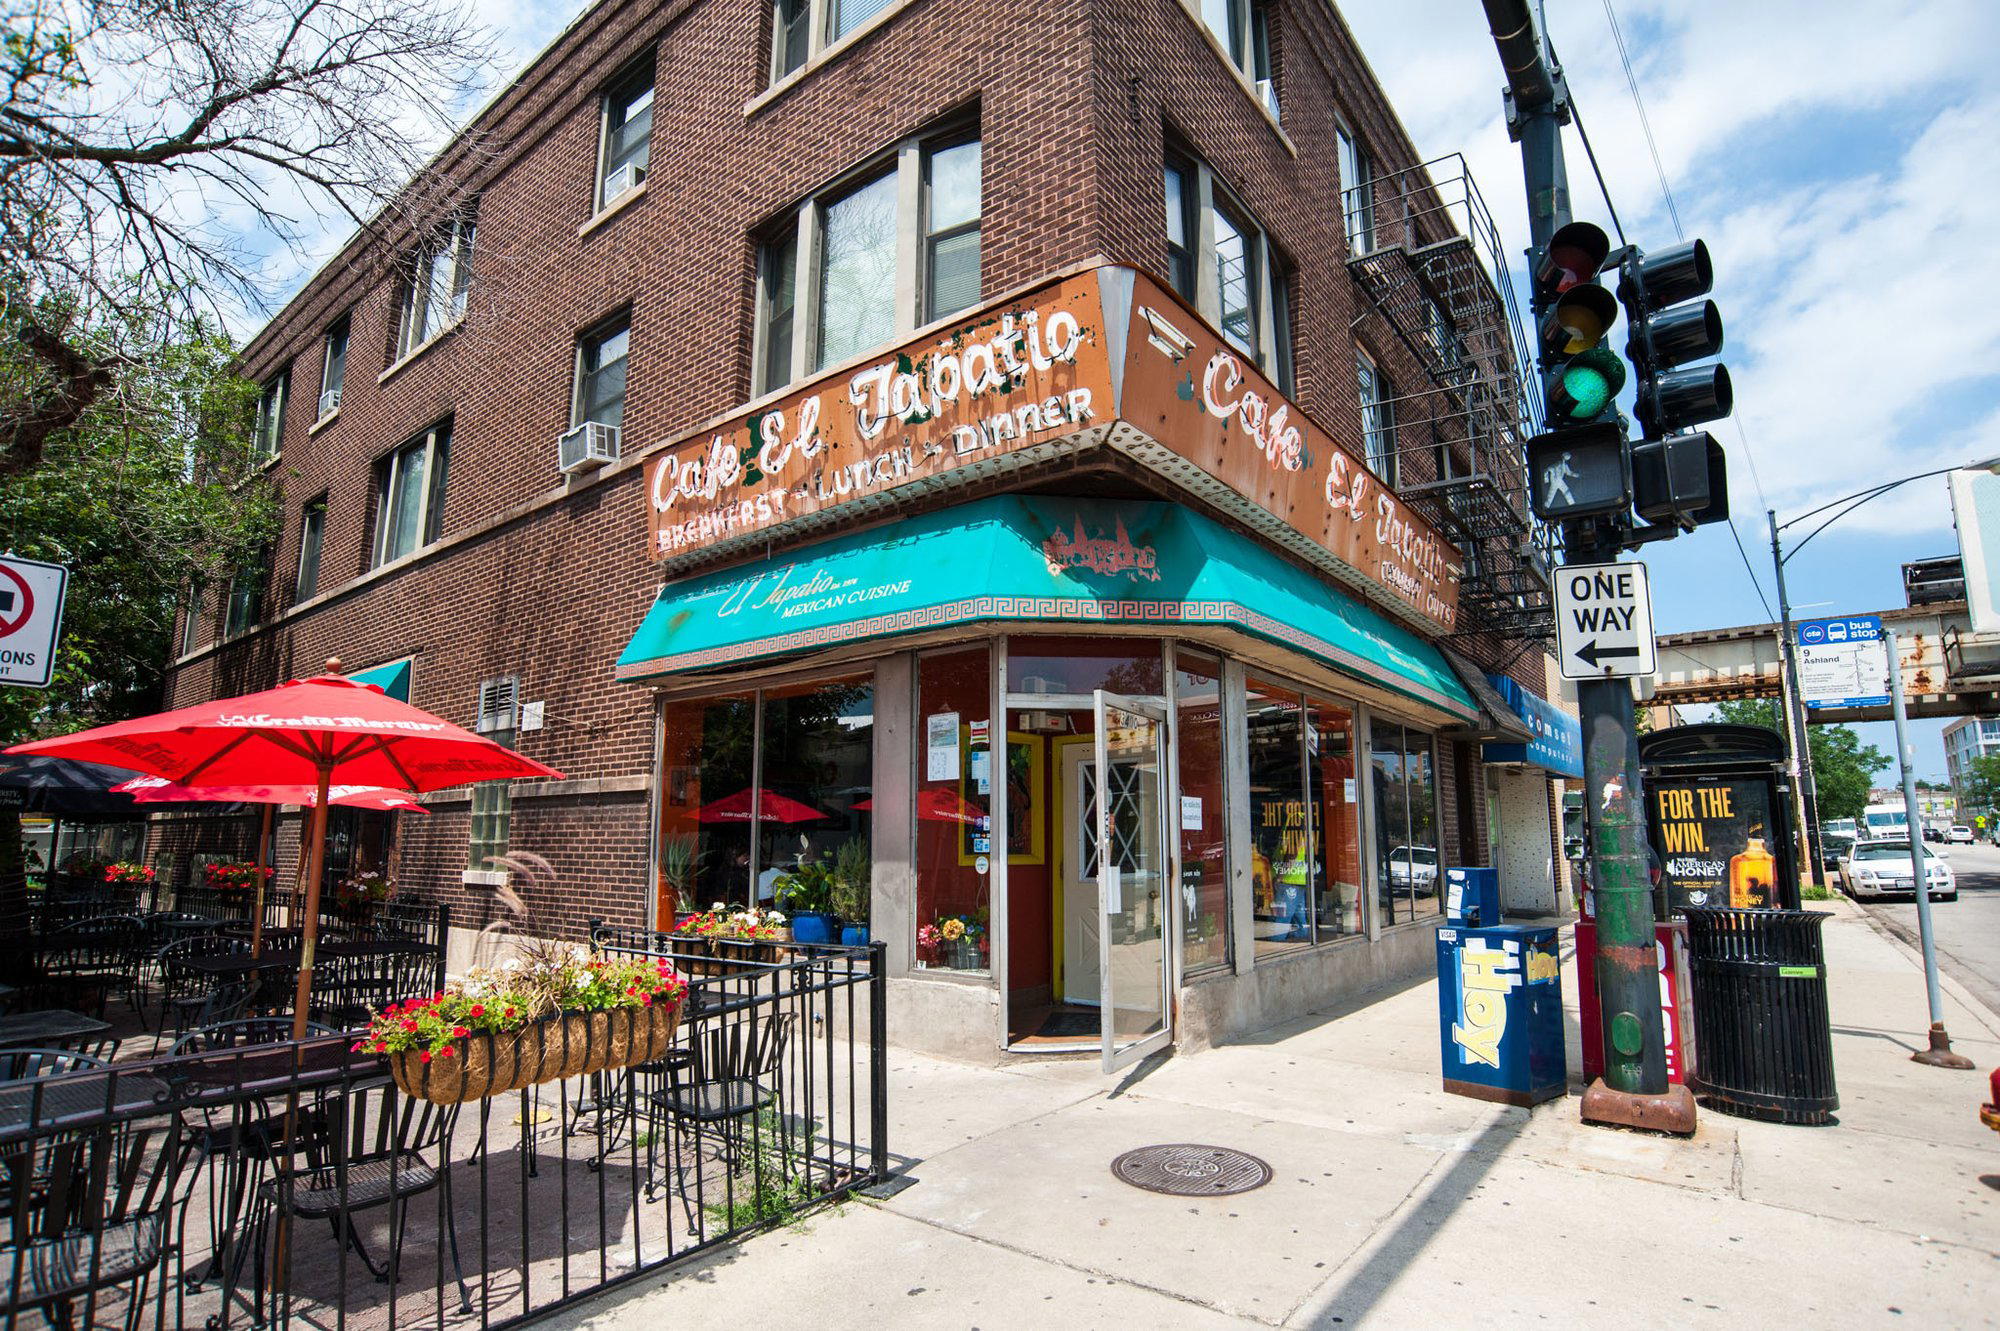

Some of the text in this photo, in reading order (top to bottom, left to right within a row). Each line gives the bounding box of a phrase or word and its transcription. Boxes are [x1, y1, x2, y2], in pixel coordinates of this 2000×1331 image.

[651, 309, 1081, 513] Cafe El Tapatio
[1203, 351, 1303, 472] Cafe
[1325, 451, 1368, 522] El
[718, 562, 834, 618] El Tapatio
[781, 594, 845, 619] MEXICAN
[847, 580, 912, 604] CUISINE
[1570, 573, 1635, 602] ONE
[1573, 605, 1636, 633] WAY
[1849, 621, 1872, 630] bus
[1850, 629, 1878, 639] stop
[0, 650, 35, 666] ONS
[1803, 649, 1811, 657] 9
[1804, 656, 1840, 664] Ashland
[1658, 787, 1735, 820] FOR THE
[1662, 822, 1710, 853] WIN.
[1675, 860, 1725, 868] AMERICAN
[1675, 867, 1724, 876] HONEY
